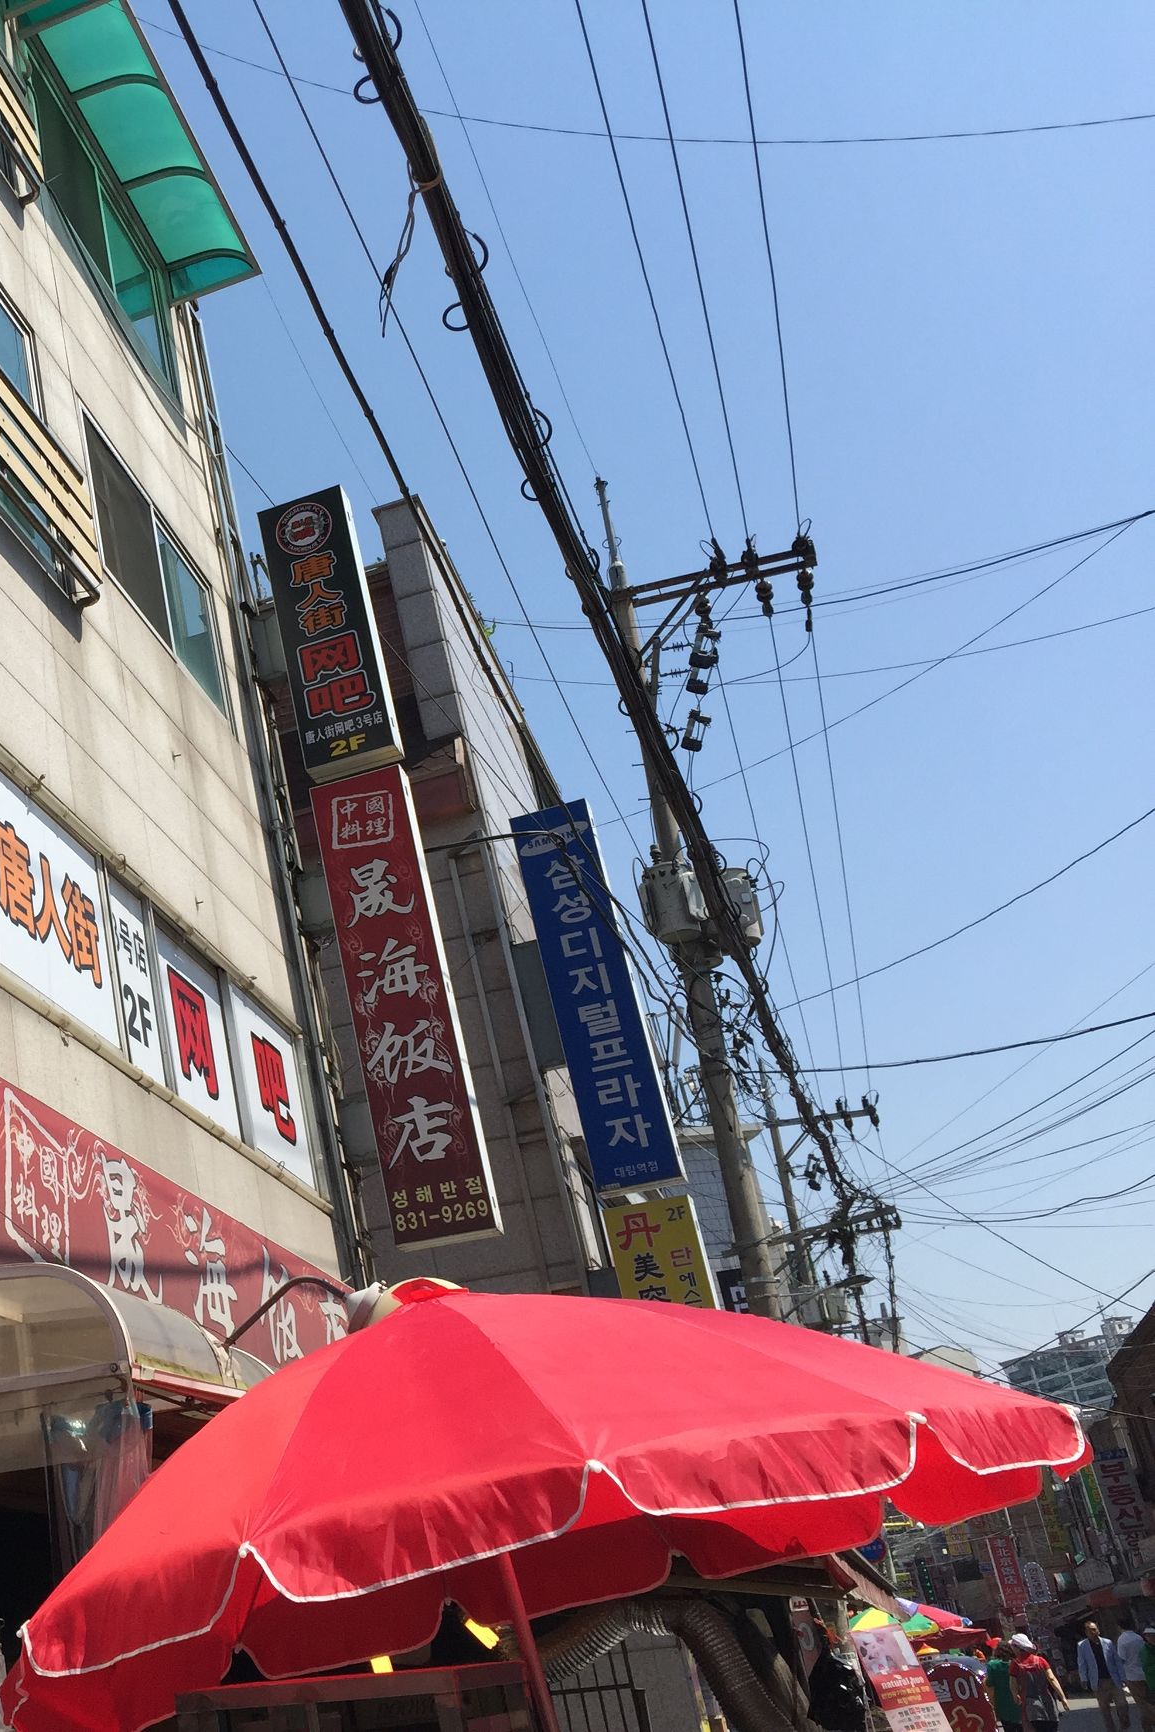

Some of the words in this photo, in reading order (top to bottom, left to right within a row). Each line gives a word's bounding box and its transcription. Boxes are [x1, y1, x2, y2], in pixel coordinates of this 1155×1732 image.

[290, 550, 346, 637] 唐人街
[296, 629, 376, 719] 网吧
[305, 710, 384, 744] 唐人街网吧3号店
[330, 733, 366, 757] 2F
[339, 795, 386, 821] 中國
[339, 817, 387, 841] 料理
[123, 983, 153, 1049] 2F
[392, 1176, 484, 1208] 성해반점
[396, 1199, 489, 1232] 831-9269
[666, 1205, 685, 1221] 2F
[670, 1247, 692, 1267] 단
